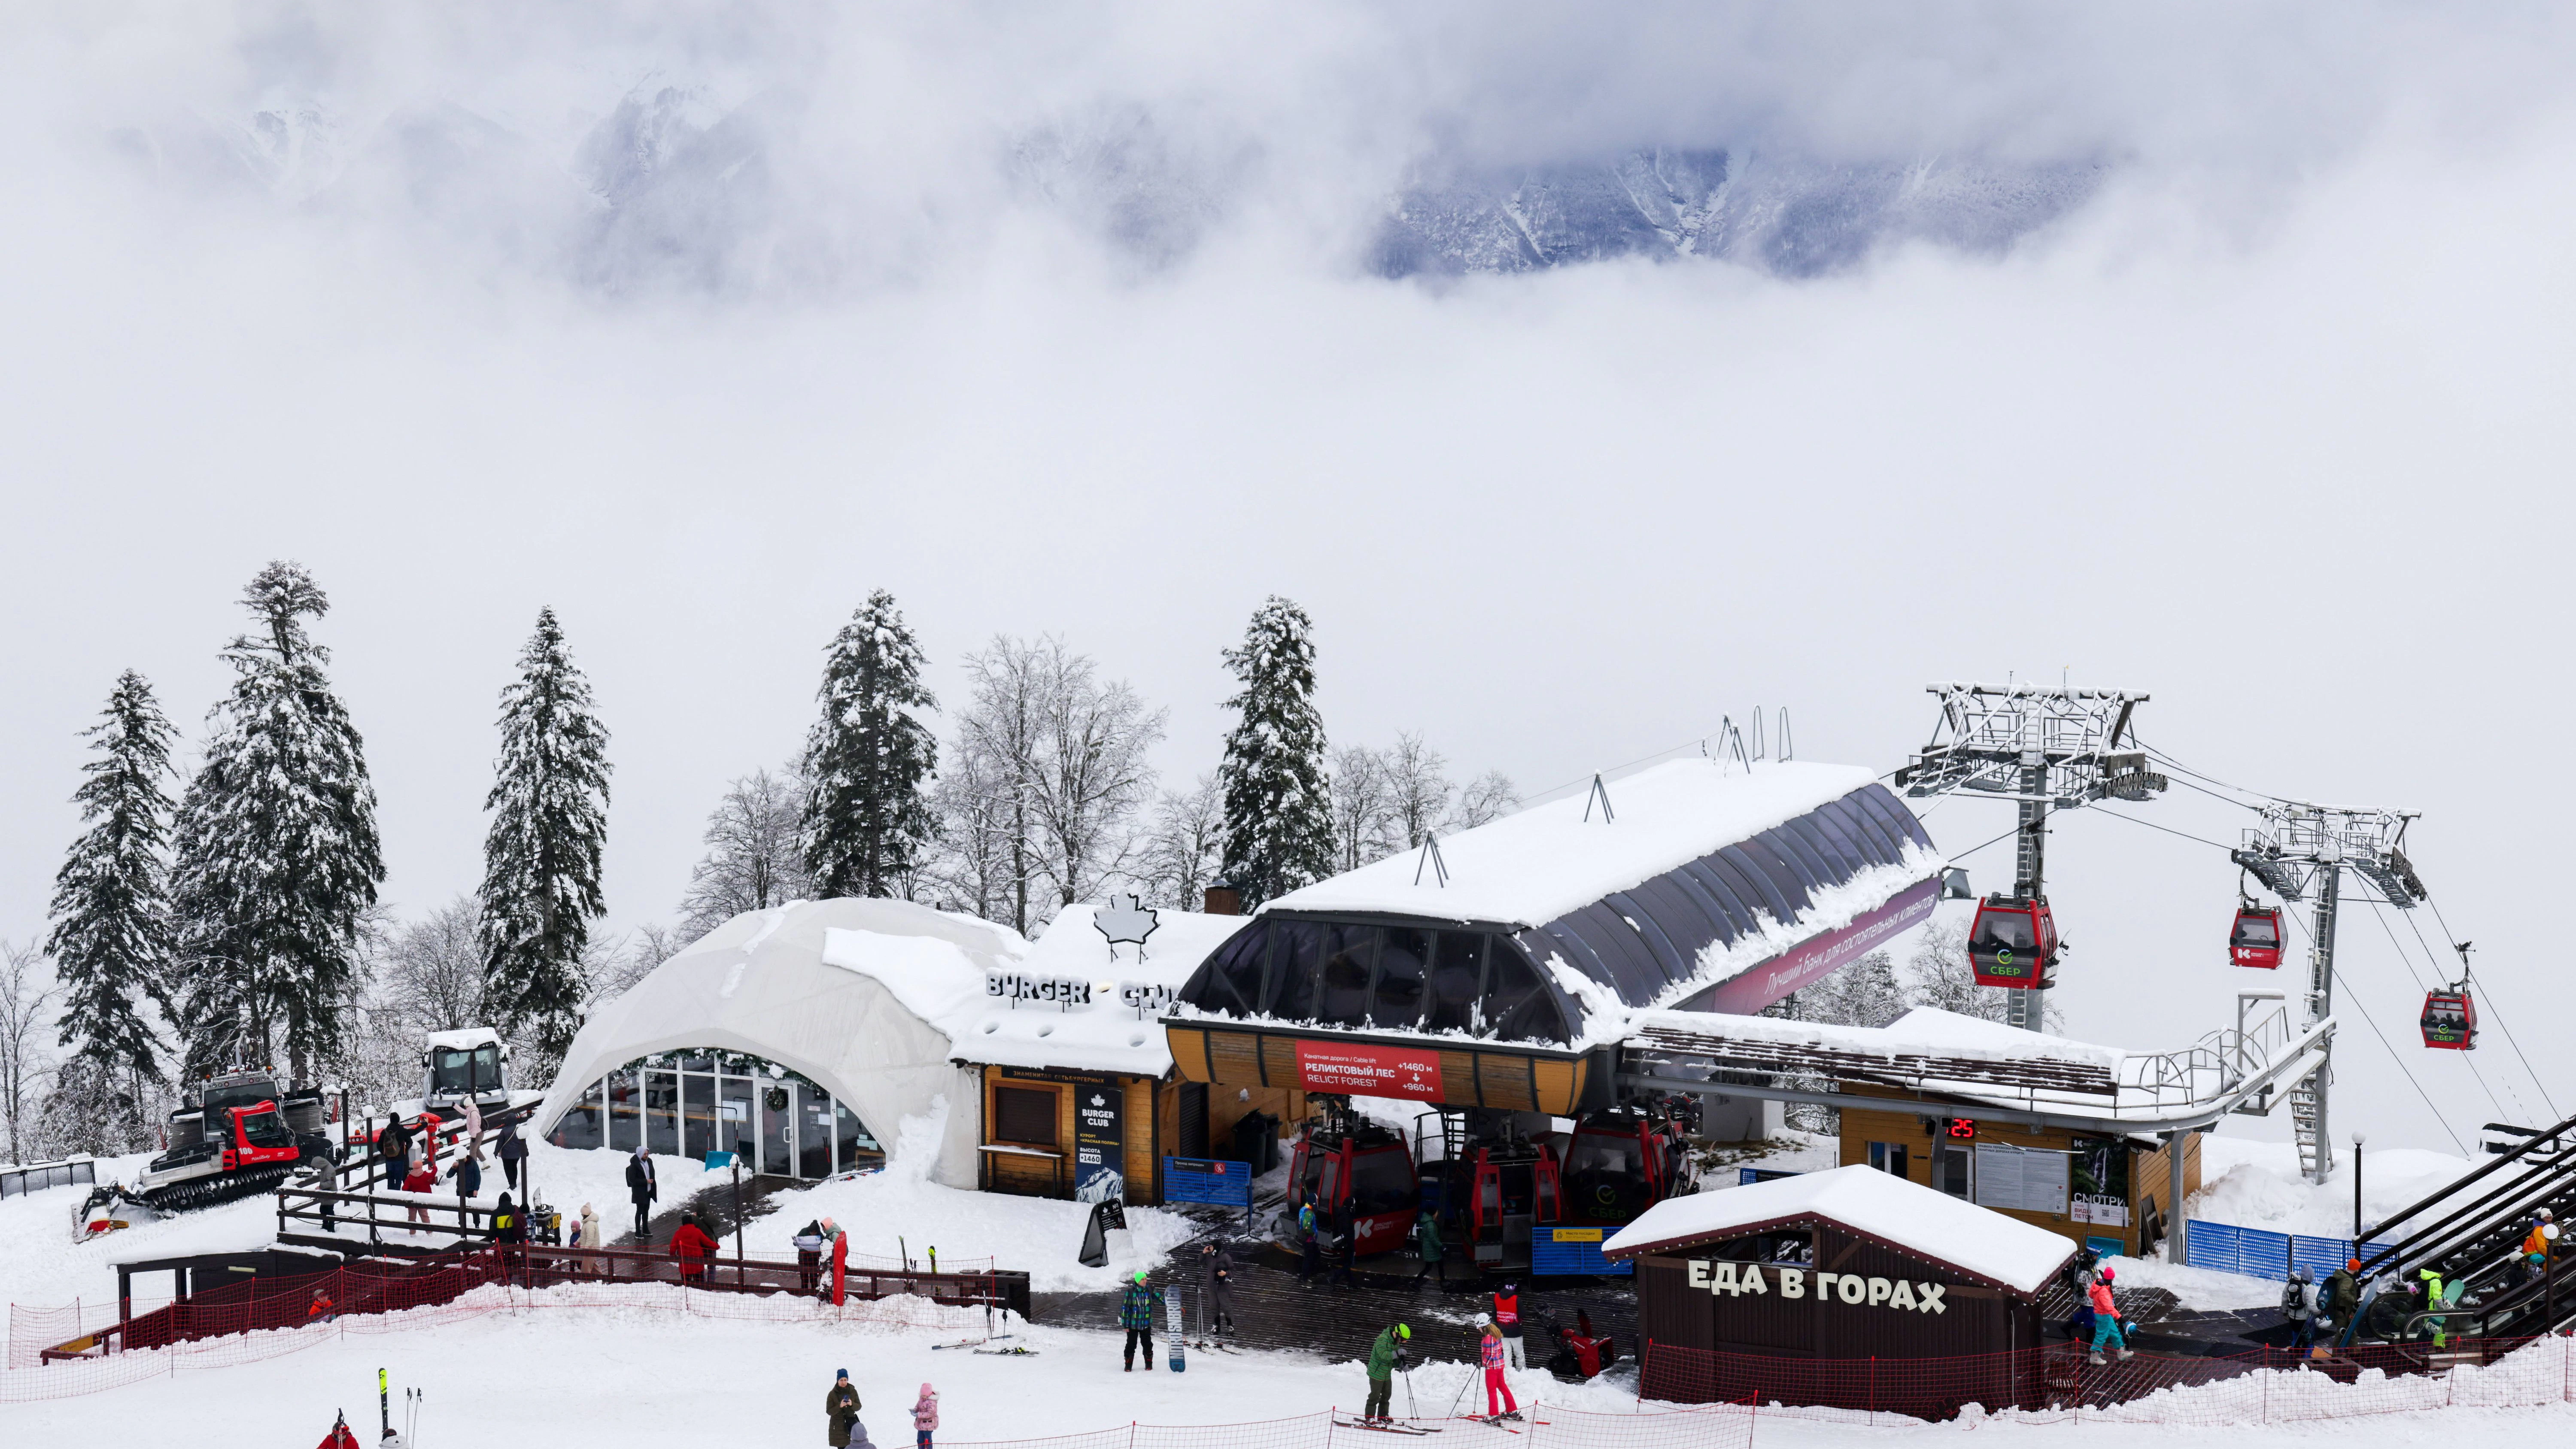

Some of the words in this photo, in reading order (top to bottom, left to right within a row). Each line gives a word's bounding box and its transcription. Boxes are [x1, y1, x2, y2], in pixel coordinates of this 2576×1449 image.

[1765, 957, 1803, 995] Лучший
[1803, 953, 1824, 975] банк
[1823, 943, 1841, 967] для
[1841, 912, 1900, 954] состоятельных
[1899, 893, 1935, 923] клиентов
[1990, 966, 2020, 976] СБЕР
[986, 971, 1090, 1003] BURGER
[1305, 1063, 1374, 1076] РЕЛИКТОВЫЙ
[1376, 1069, 1395, 1078] ЛЕС
[1398, 1062, 1424, 1072] +1460
[1307, 1074, 1339, 1084] RELICT
[1341, 1077, 1377, 1087] FOREST
[1403, 1083, 1425, 1092] +960
[1082, 1109, 1114, 1118] BURGER
[1088, 1118, 1109, 1127] CLUB
[2074, 1193, 2125, 1206] СМОТРИ
[1589, 1207, 1626, 1219] СБЕР
[1688, 1260, 1768, 1297] ЕДА
[1780, 1268, 1805, 1299] В
[1817, 1272, 1947, 1315] ГОРАХ
